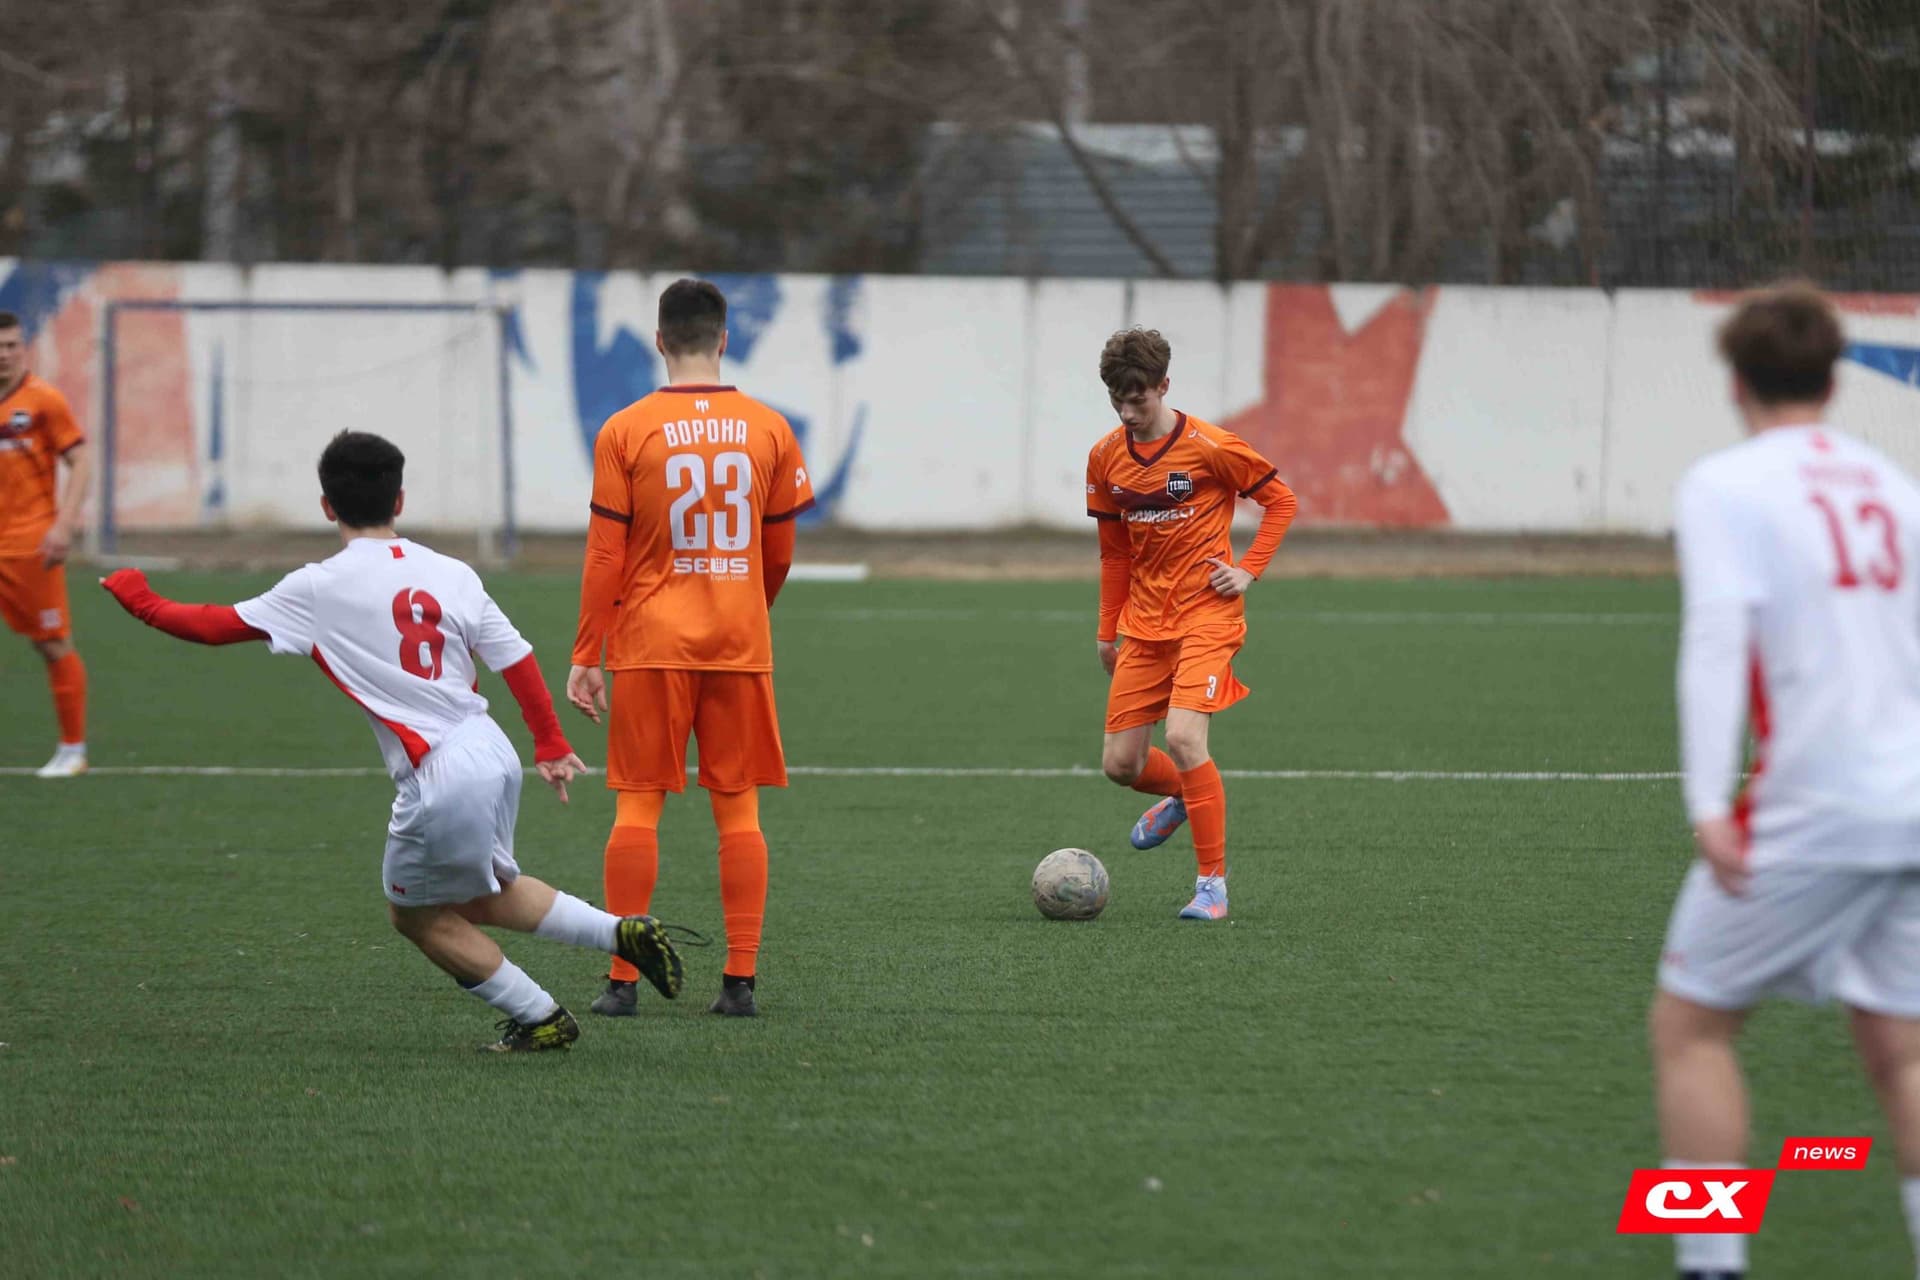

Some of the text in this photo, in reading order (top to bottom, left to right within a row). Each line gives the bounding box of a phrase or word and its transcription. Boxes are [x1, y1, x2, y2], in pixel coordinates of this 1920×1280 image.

[663, 418, 747, 448] ВОРОНА
[665, 451, 752, 551] 23
[673, 557, 750, 574] SEUS
[1809, 493, 1904, 591] 13
[391, 586, 446, 682] 8
[1206, 675, 1217, 699] 3
